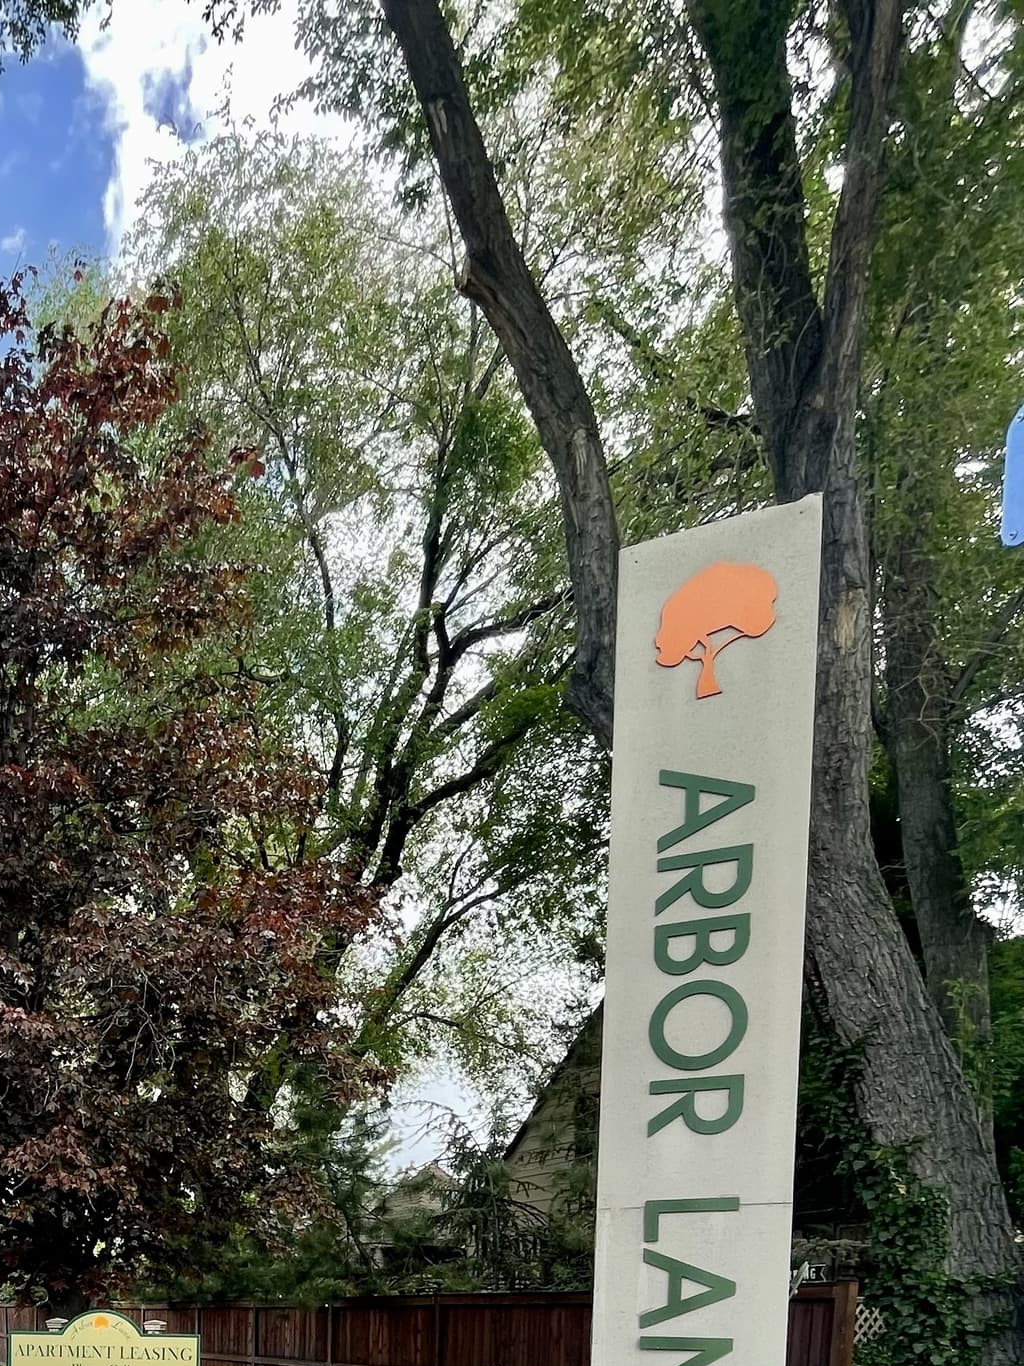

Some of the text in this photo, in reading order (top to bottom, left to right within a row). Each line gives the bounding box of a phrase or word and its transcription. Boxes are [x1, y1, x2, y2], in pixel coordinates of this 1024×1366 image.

[647, 769, 756, 1138] ARBOR
[14, 1343, 193, 1362] APARTMENT LEASING
